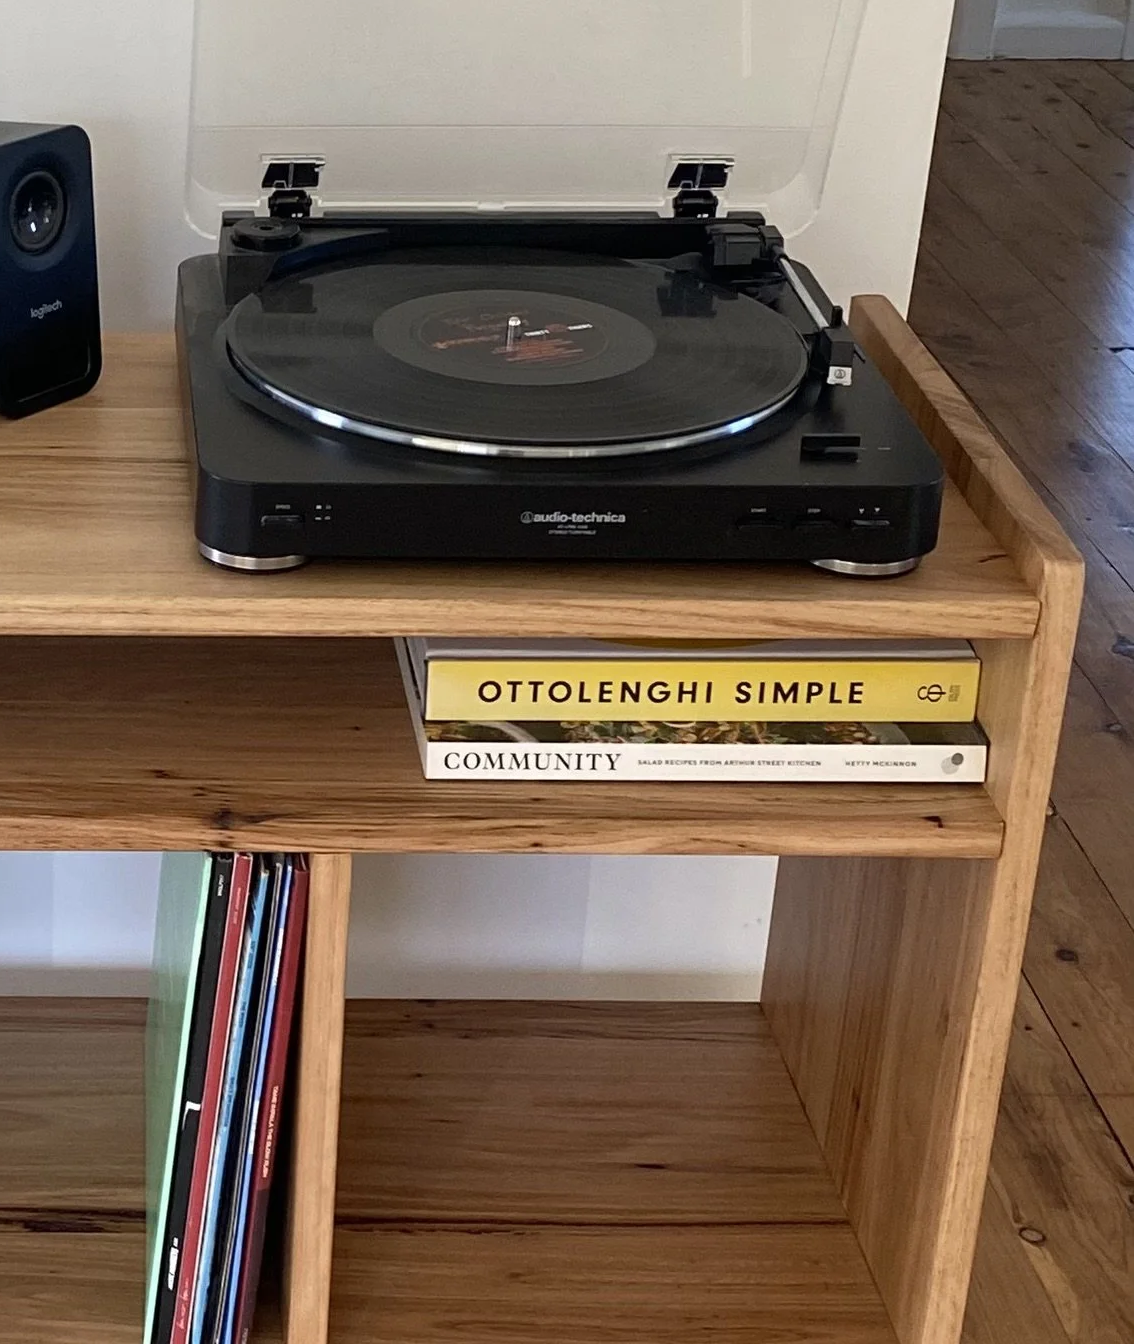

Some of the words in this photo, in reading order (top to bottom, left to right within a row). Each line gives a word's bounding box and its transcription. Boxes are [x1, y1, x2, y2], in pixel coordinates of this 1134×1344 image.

[30, 299, 63, 319] logitech
[533, 511, 626, 523] audio-technica
[478, 680, 713, 704] OTTOLENGHI
[734, 681, 864, 704] SIMPLE
[443, 752, 622, 771] COMMUNITY
